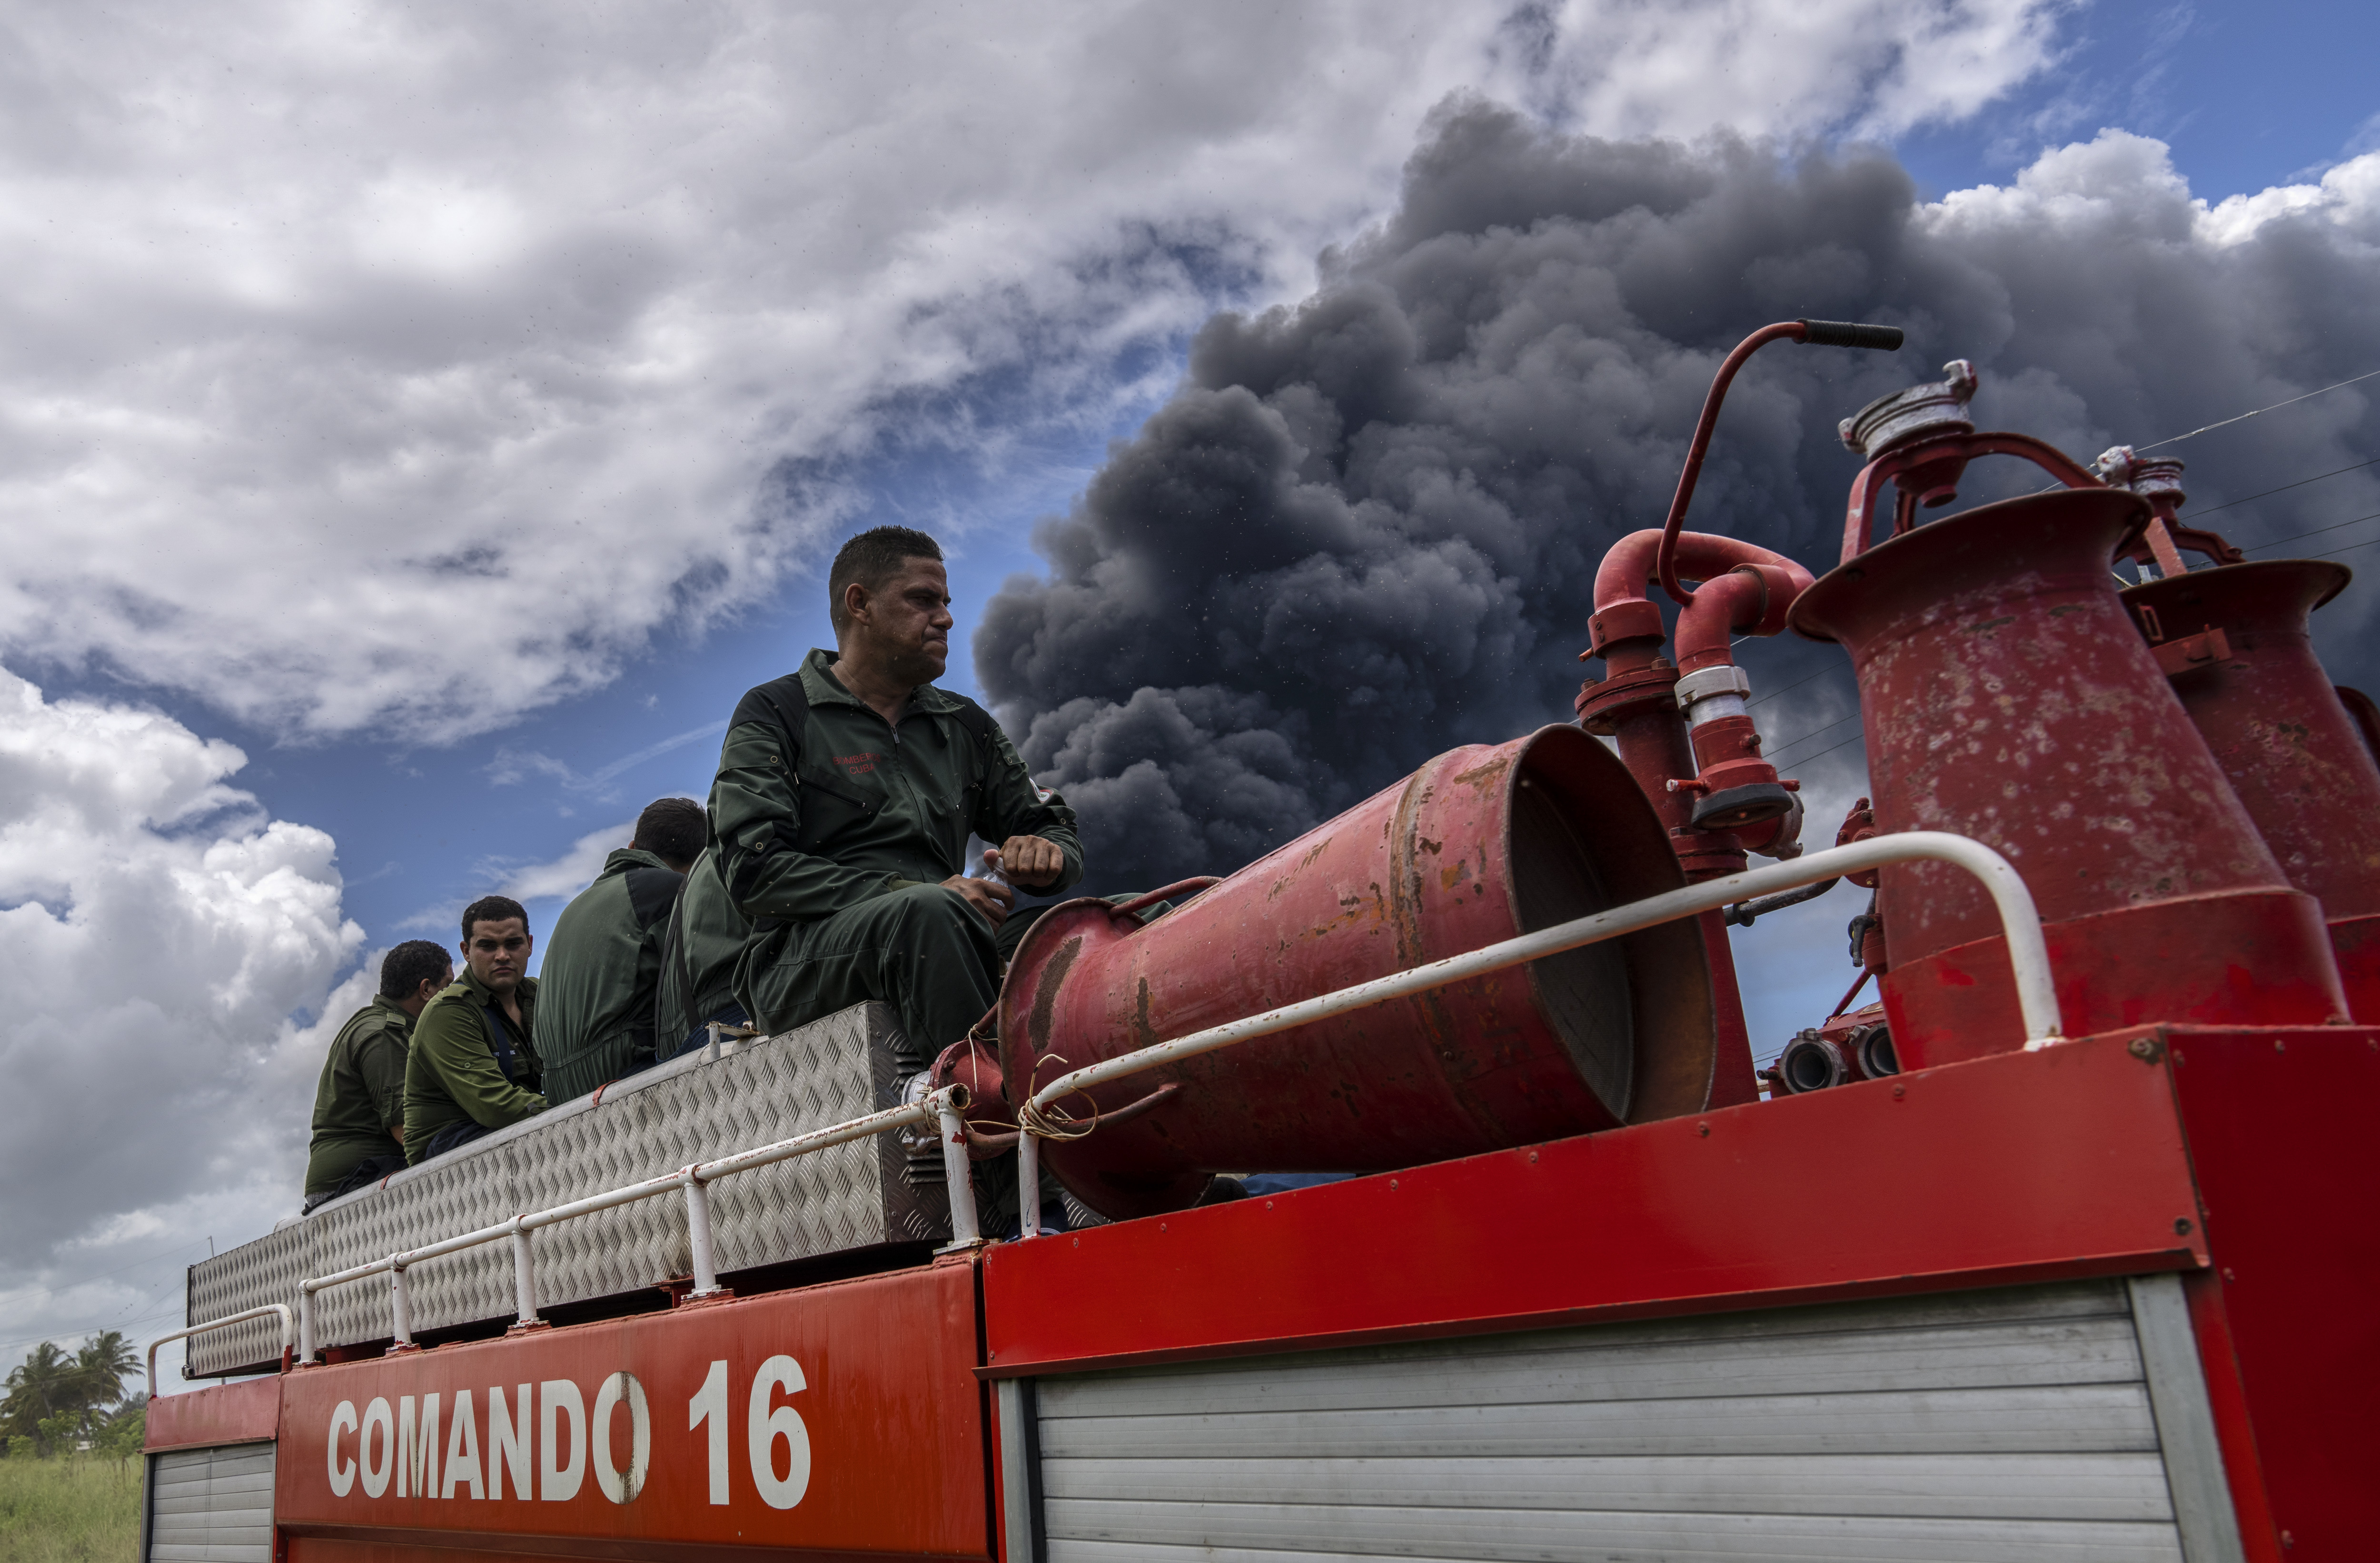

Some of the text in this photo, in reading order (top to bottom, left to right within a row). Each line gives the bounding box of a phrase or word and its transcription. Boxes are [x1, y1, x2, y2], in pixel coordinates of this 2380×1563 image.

[833, 752, 881, 765] BOMBEROS
[849, 763, 875, 774] CUBA
[327, 1355, 811, 1510] COMANDO 16
